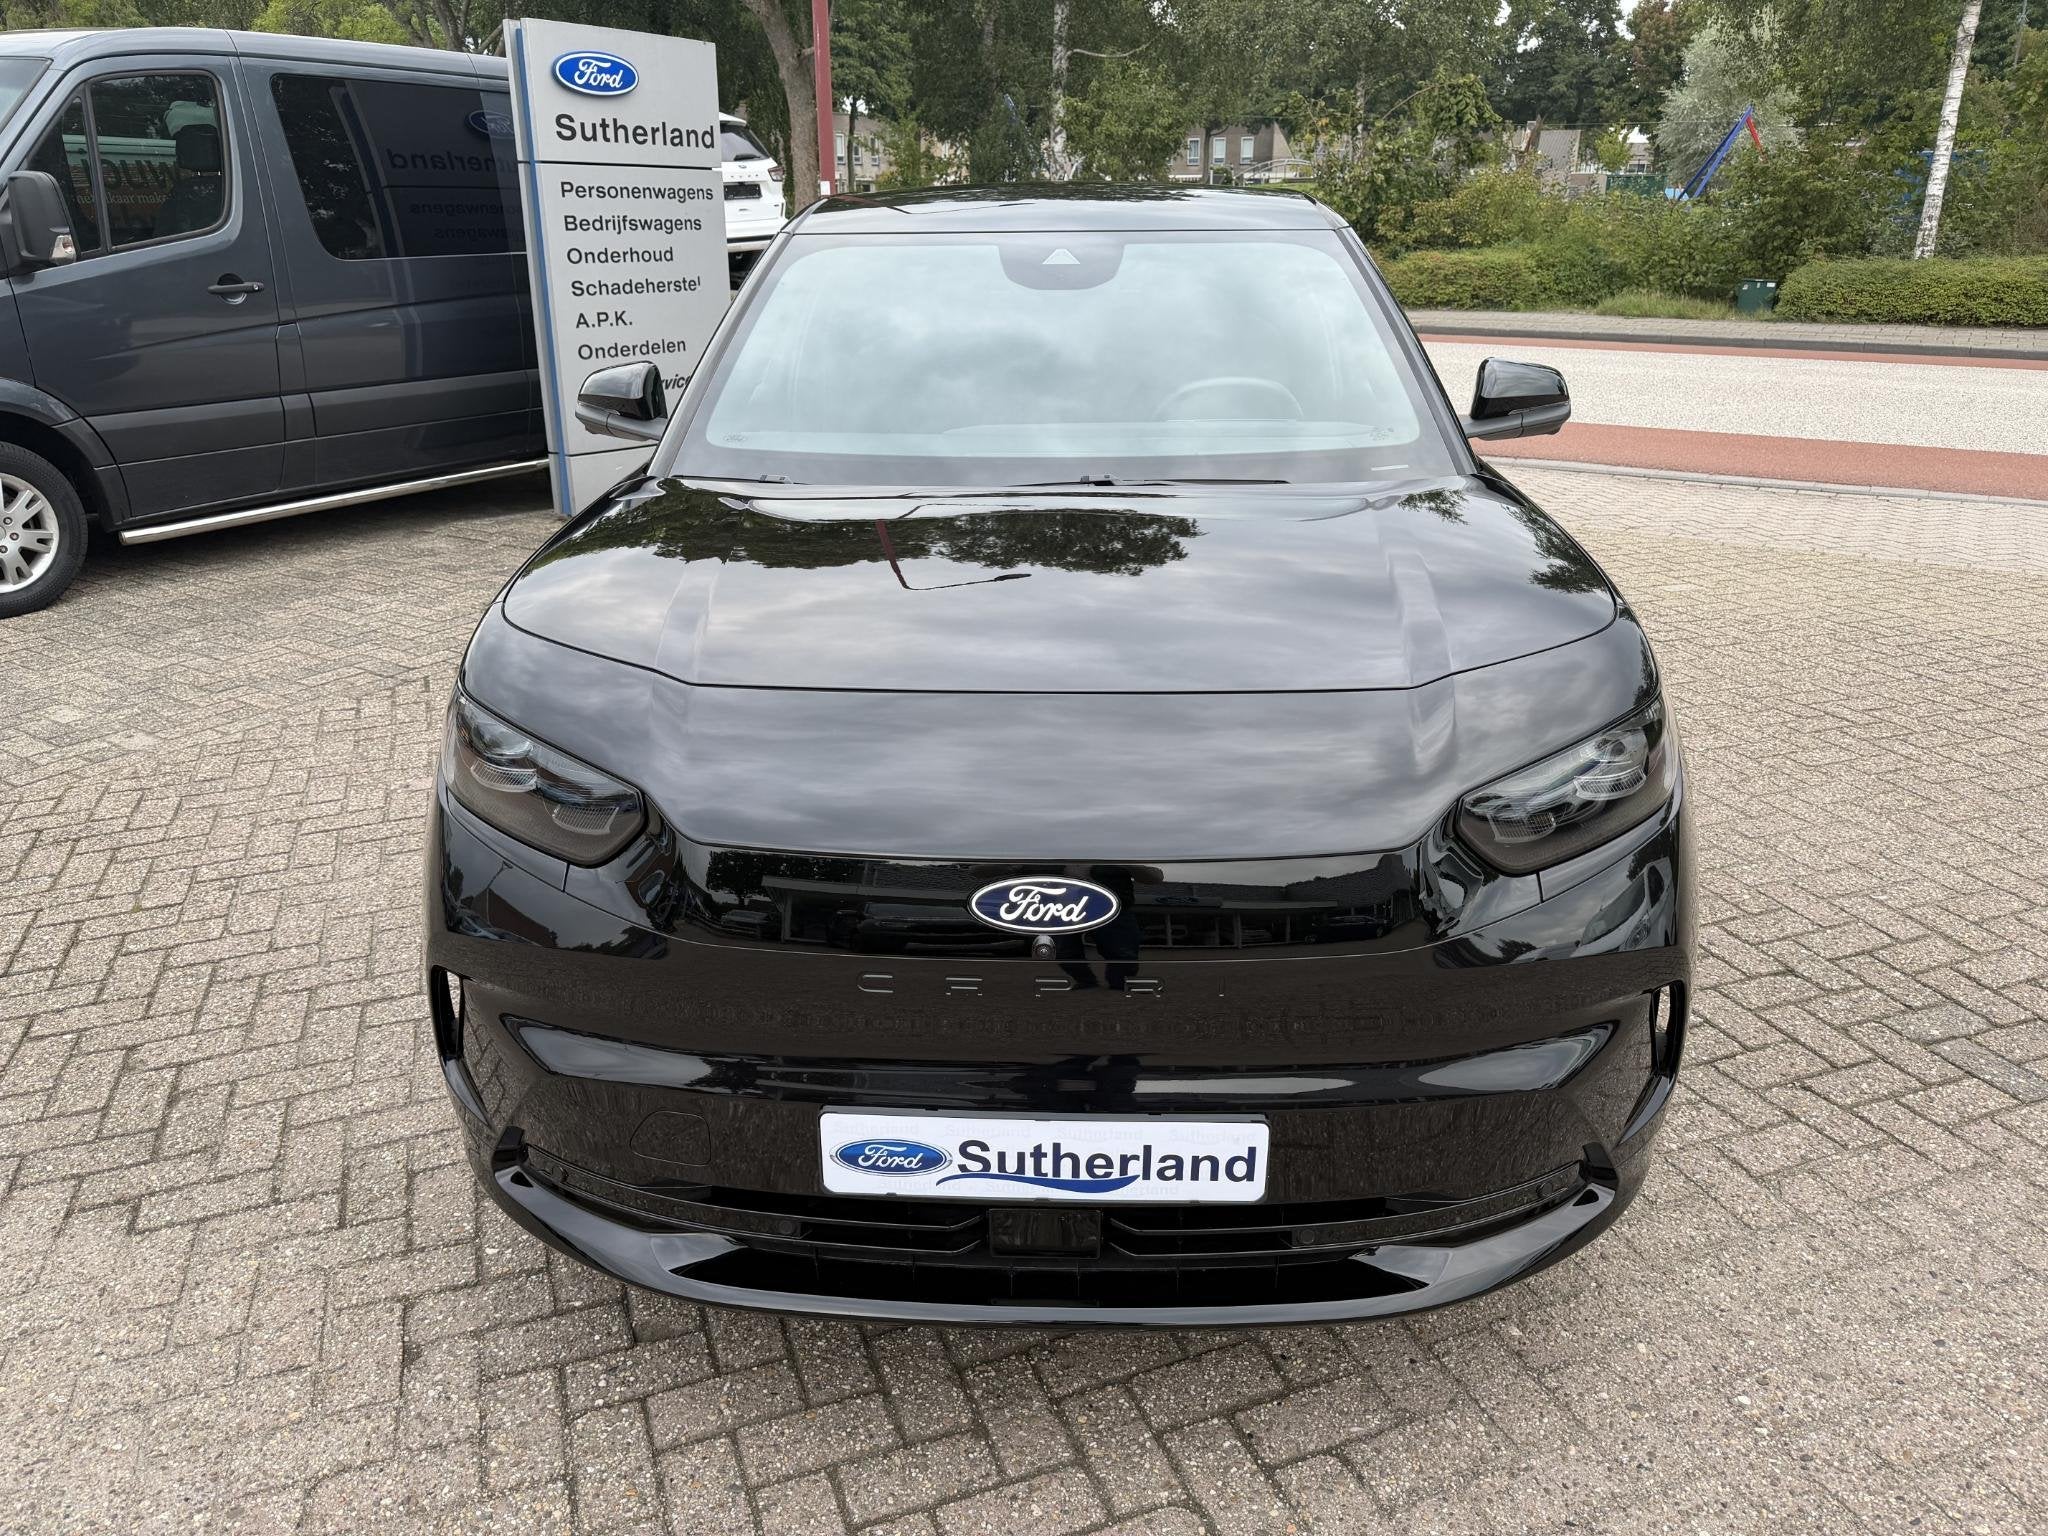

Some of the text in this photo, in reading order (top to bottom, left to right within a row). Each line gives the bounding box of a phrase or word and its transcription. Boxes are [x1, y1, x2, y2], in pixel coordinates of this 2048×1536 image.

[574, 58, 624, 88] Ford
[555, 113, 715, 149] Sutherland
[560, 181, 714, 204] Personenwagens
[564, 215, 702, 235] Bedrijfswagens
[566, 246, 674, 265] Onderhoud
[575, 310, 633, 329] A.P.K.
[577, 338, 687, 360] Onderdelen
[1000, 885, 1089, 922] Ford
[858, 1139, 1257, 1182] Ford Sutherland
